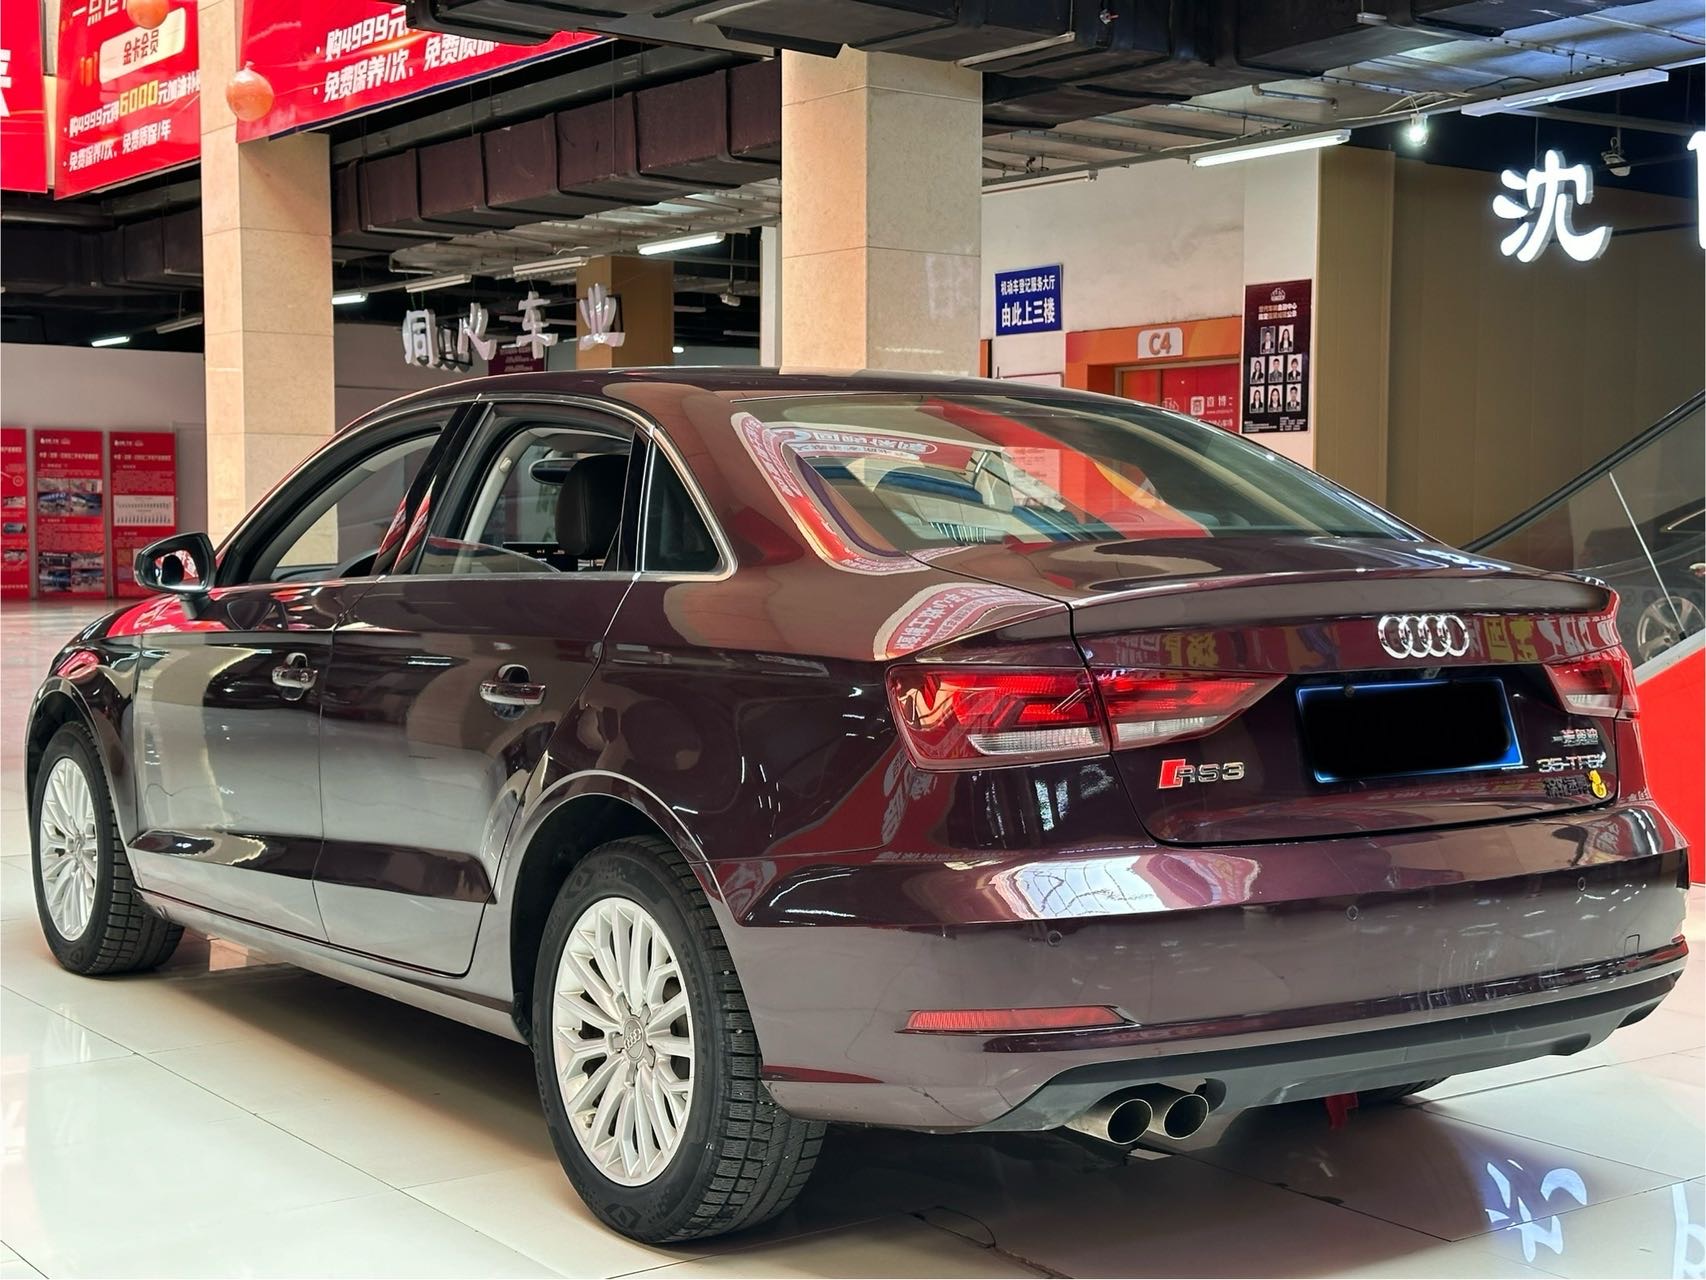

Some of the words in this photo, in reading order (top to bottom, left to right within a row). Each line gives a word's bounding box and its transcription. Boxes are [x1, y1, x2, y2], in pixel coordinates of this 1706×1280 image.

[325, 4, 412, 62] 购4999元
[123, 29, 159, 66] 金卡会员
[1000, 275, 1056, 296] 机动车登记服务大厅
[1001, 297, 1055, 328] 由此上三楼
[1149, 332, 1172, 355] C4
[1173, 761, 1245, 785] RS3
